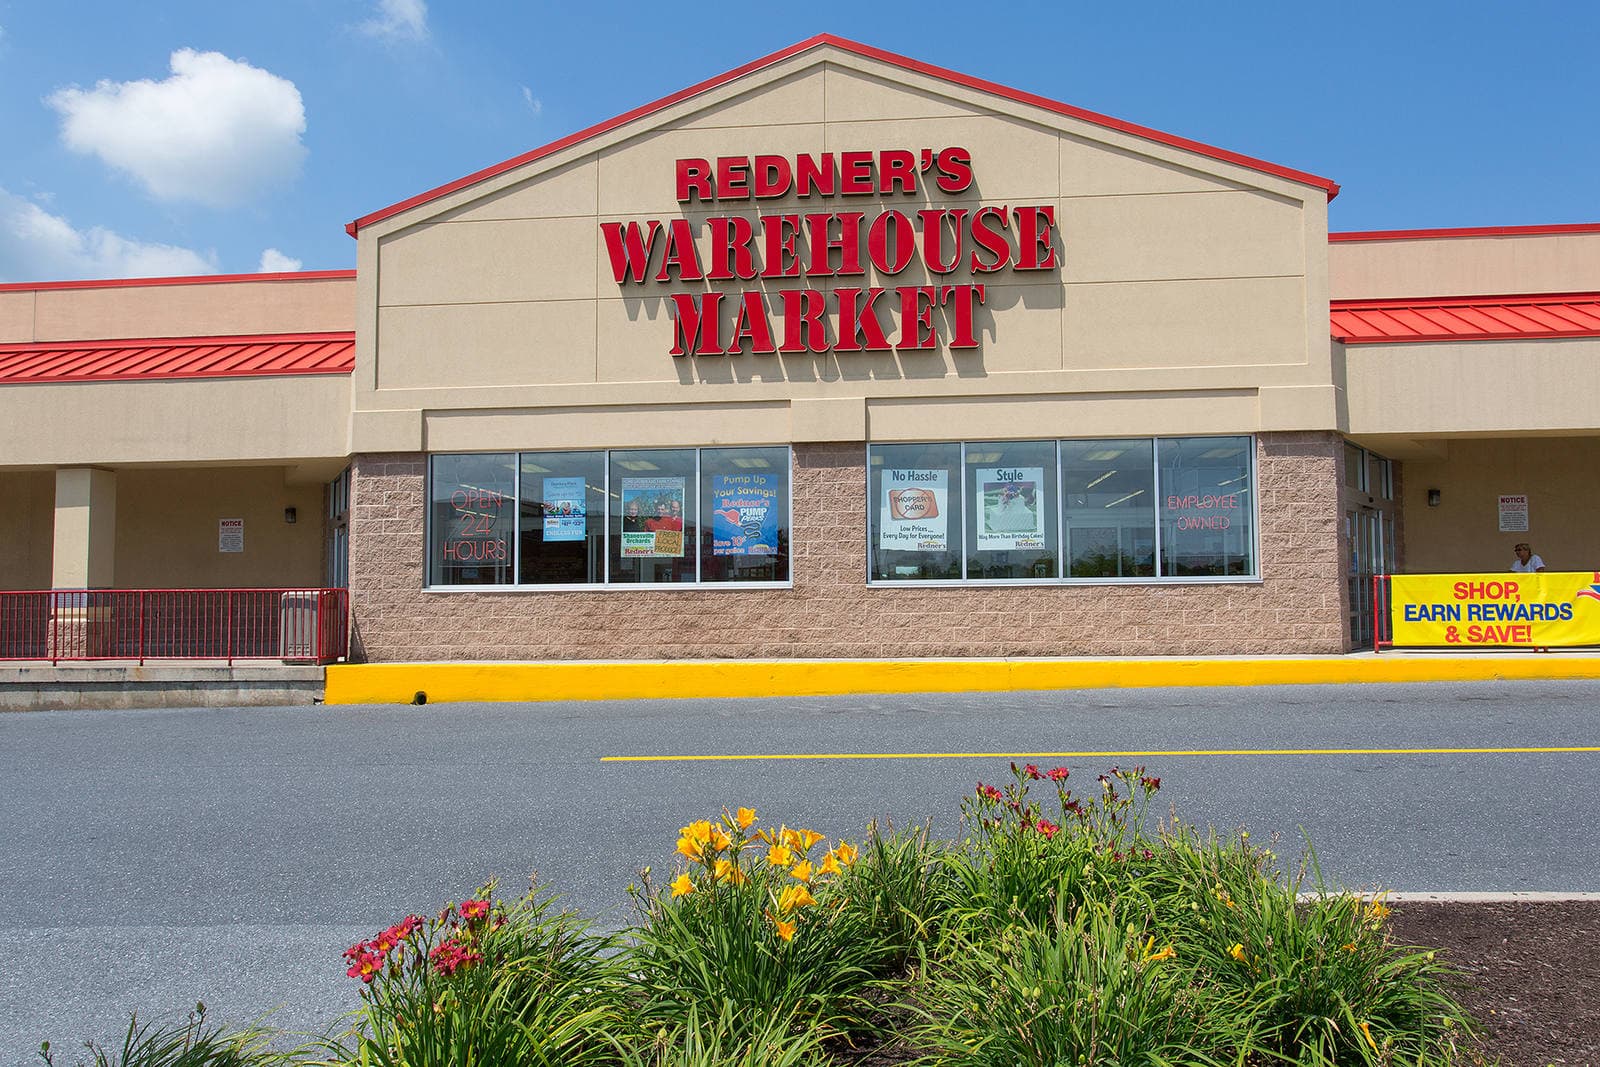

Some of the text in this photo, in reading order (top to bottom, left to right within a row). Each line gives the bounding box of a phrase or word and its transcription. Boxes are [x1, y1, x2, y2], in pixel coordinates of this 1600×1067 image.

[676, 146, 972, 202] REDNER'S
[600, 205, 1056, 284] WAREHOUSE
[669, 284, 985, 357] MARKET
[723, 475, 767, 485] Pump Up
[892, 470, 938, 481] No Hassle
[997, 469, 1024, 483] Style
[451, 489, 503, 509] OPEN
[714, 487, 777, 498] Your Savings!
[722, 498, 770, 507] Redner's
[1168, 495, 1238, 509] EMPLOYEE
[740, 507, 767, 516] PUMP
[461, 513, 491, 538] 24
[1177, 516, 1230, 530] OWNED
[883, 532, 898, 540] Every
[899, 532, 909, 540] Day
[444, 540, 507, 560] HOURS
[1453, 582, 1521, 602] SHOP,
[1404, 603, 1573, 622] EARN REWARDS
[1445, 626, 1532, 643] & SAVE!
